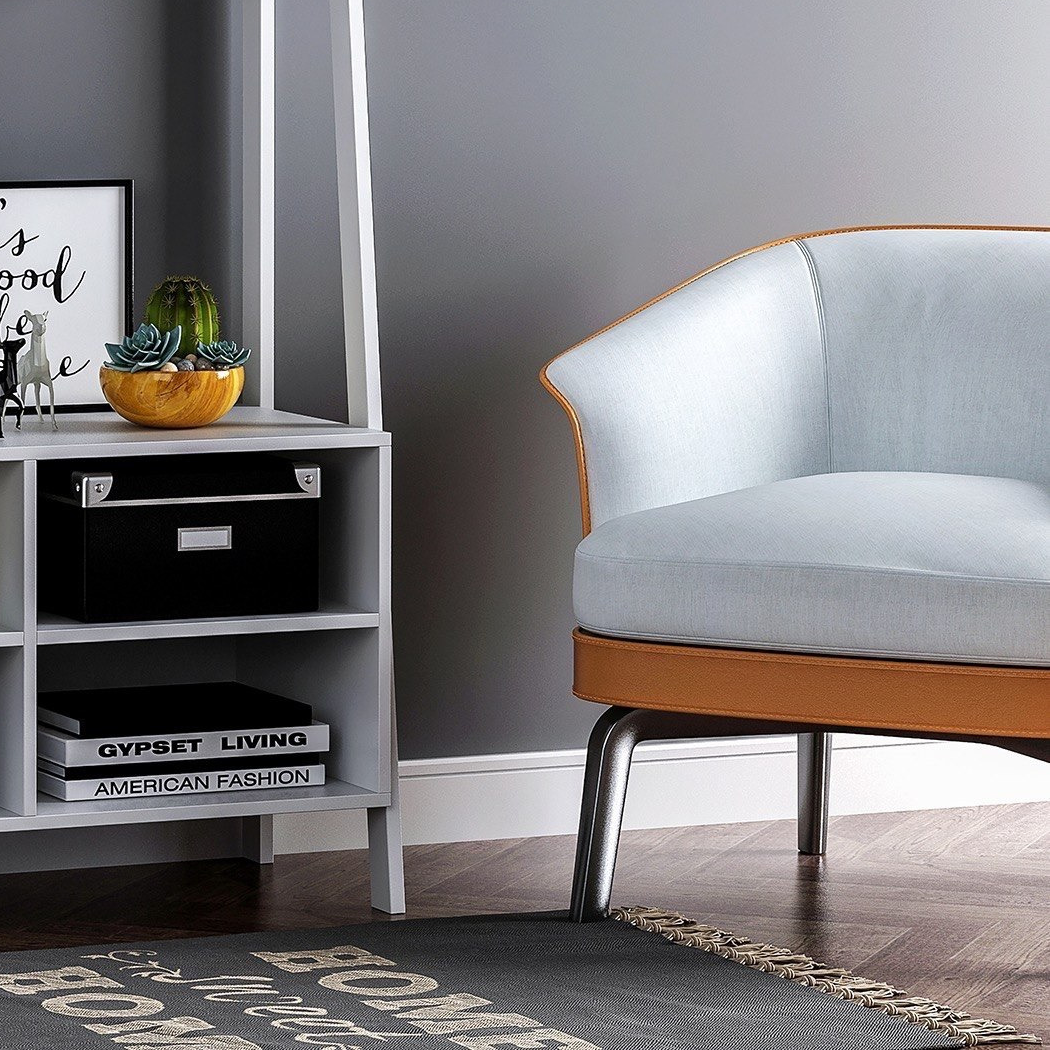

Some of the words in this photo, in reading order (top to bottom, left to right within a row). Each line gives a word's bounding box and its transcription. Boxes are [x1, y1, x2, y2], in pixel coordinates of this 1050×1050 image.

[97, 738, 203, 758] GYPSET
[221, 732, 308, 751] LIVING
[94, 775, 210, 797] AMERICAN
[217, 769, 310, 789] FASHION
